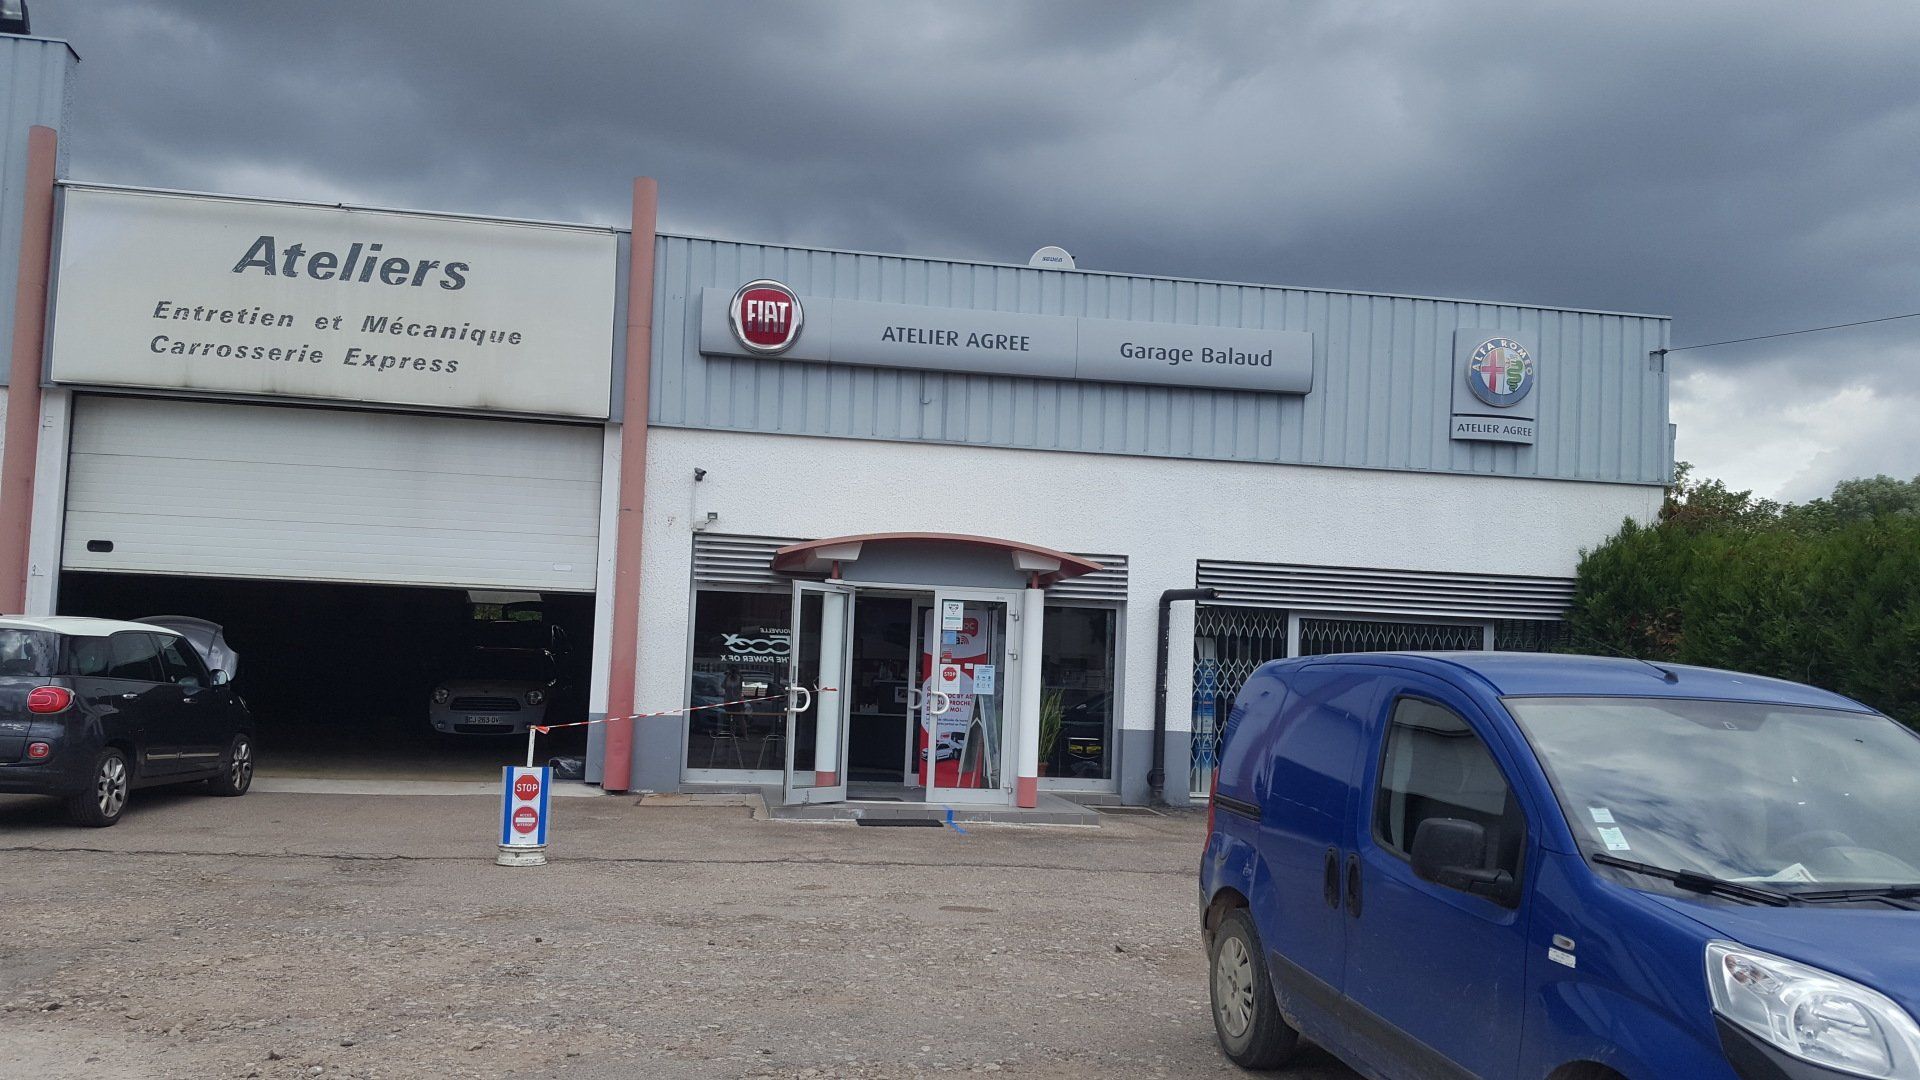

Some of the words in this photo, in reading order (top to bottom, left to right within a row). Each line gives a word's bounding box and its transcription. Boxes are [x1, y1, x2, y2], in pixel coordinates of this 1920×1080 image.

[231, 235, 470, 290] Ateliers
[152, 300, 295, 328] Entretien
[314, 315, 343, 330] et
[361, 314, 522, 346] Mécanique
[747, 299, 789, 334] FIAT
[150, 335, 324, 364] Carrosserie
[342, 347, 459, 374] Express
[881, 326, 959, 347] ATELIER
[966, 332, 1030, 351] AGREE
[1120, 342, 1193, 366] Garage
[1201, 347, 1273, 367] Balaud
[1471, 341, 1496, 372] ALFA
[1501, 339, 1533, 376] ROMEO
[1457, 423, 1500, 434] ATELIER
[1502, 425, 1533, 437] AGREE
[516, 783, 538, 792] STOP
